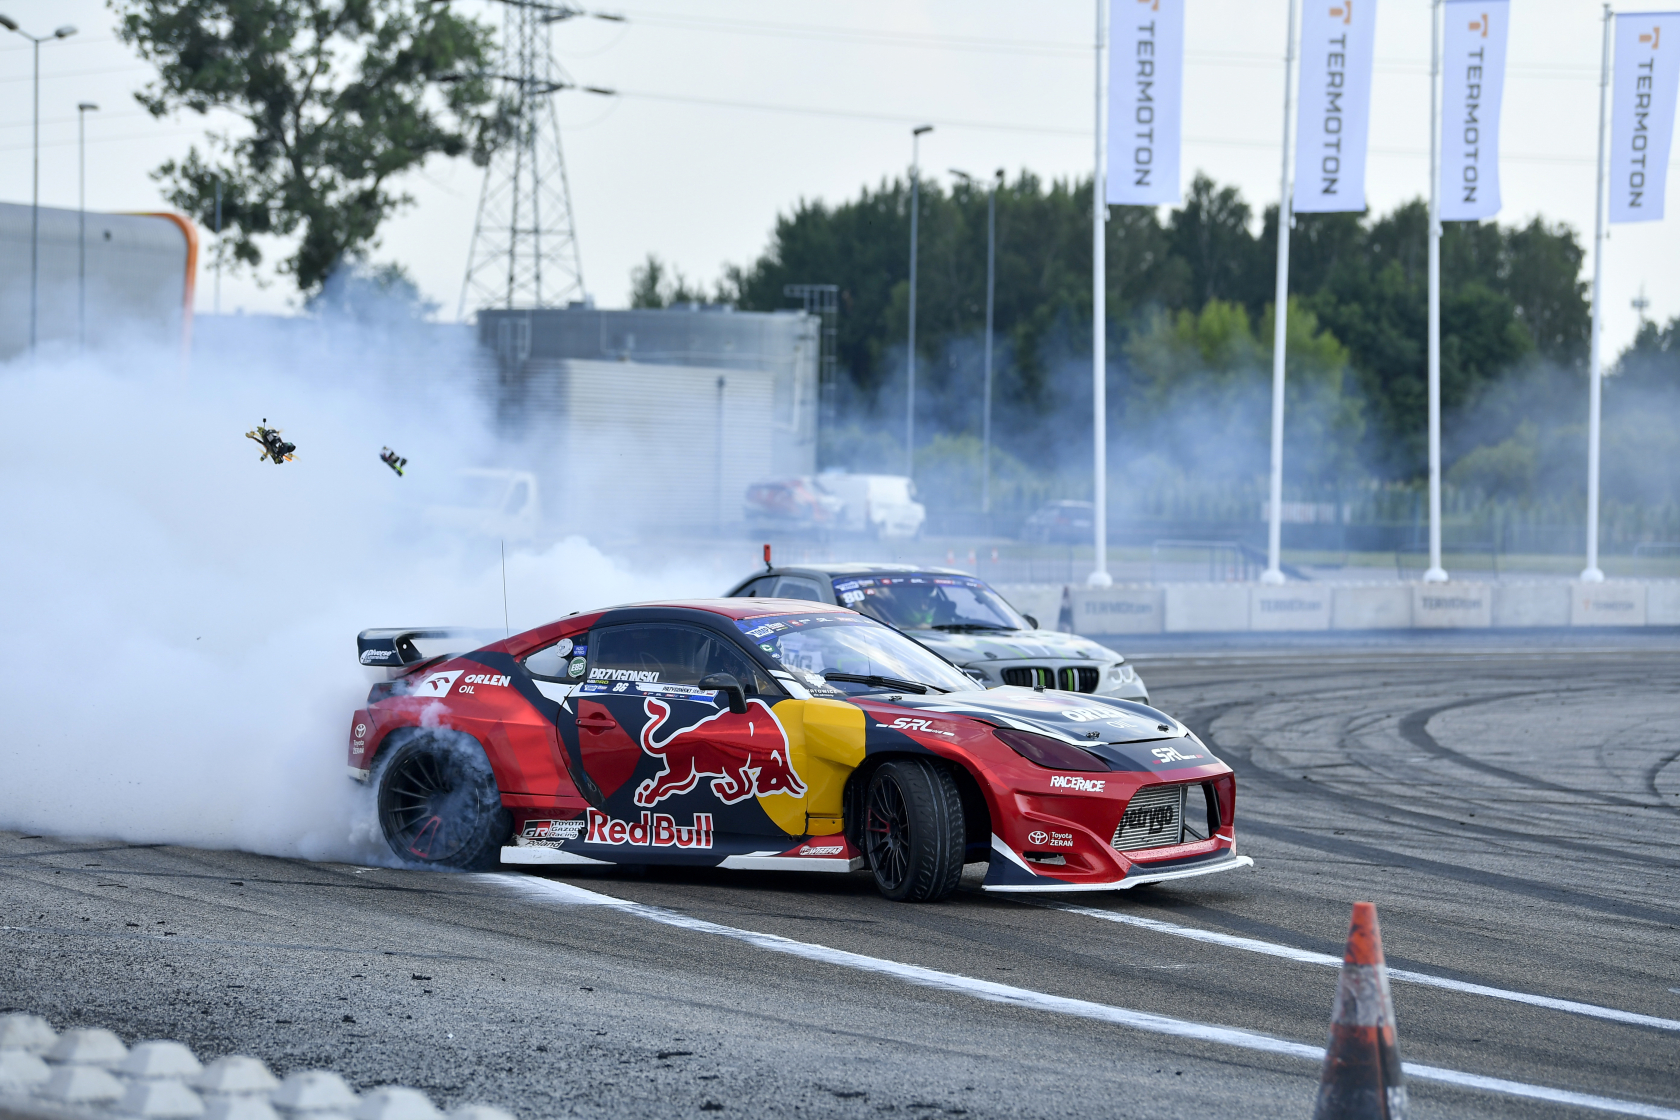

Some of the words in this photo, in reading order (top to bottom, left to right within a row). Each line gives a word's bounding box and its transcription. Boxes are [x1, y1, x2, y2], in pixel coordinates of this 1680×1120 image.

[1134, 20, 1156, 188] TERMOTON
[1321, 32, 1348, 196] TERMOTON
[1462, 45, 1485, 205] TERMOTON
[1628, 56, 1655, 209] TERMOTON
[843, 589, 866, 603] 80
[570, 662, 584, 672] E85
[464, 674, 512, 688] ORLEN
[612, 682, 630, 693] 86
[458, 684, 475, 695] OIL
[887, 717, 934, 733] SRL
[1150, 746, 1191, 764] SRL
[1050, 776, 1105, 792] RACERACE
[585, 808, 650, 845] Red
[652, 813, 713, 849] Bull
[1117, 804, 1174, 839] petrygo
[522, 827, 549, 838] GR
[1051, 831, 1073, 840] Toyota
[526, 839, 563, 848] Poland
